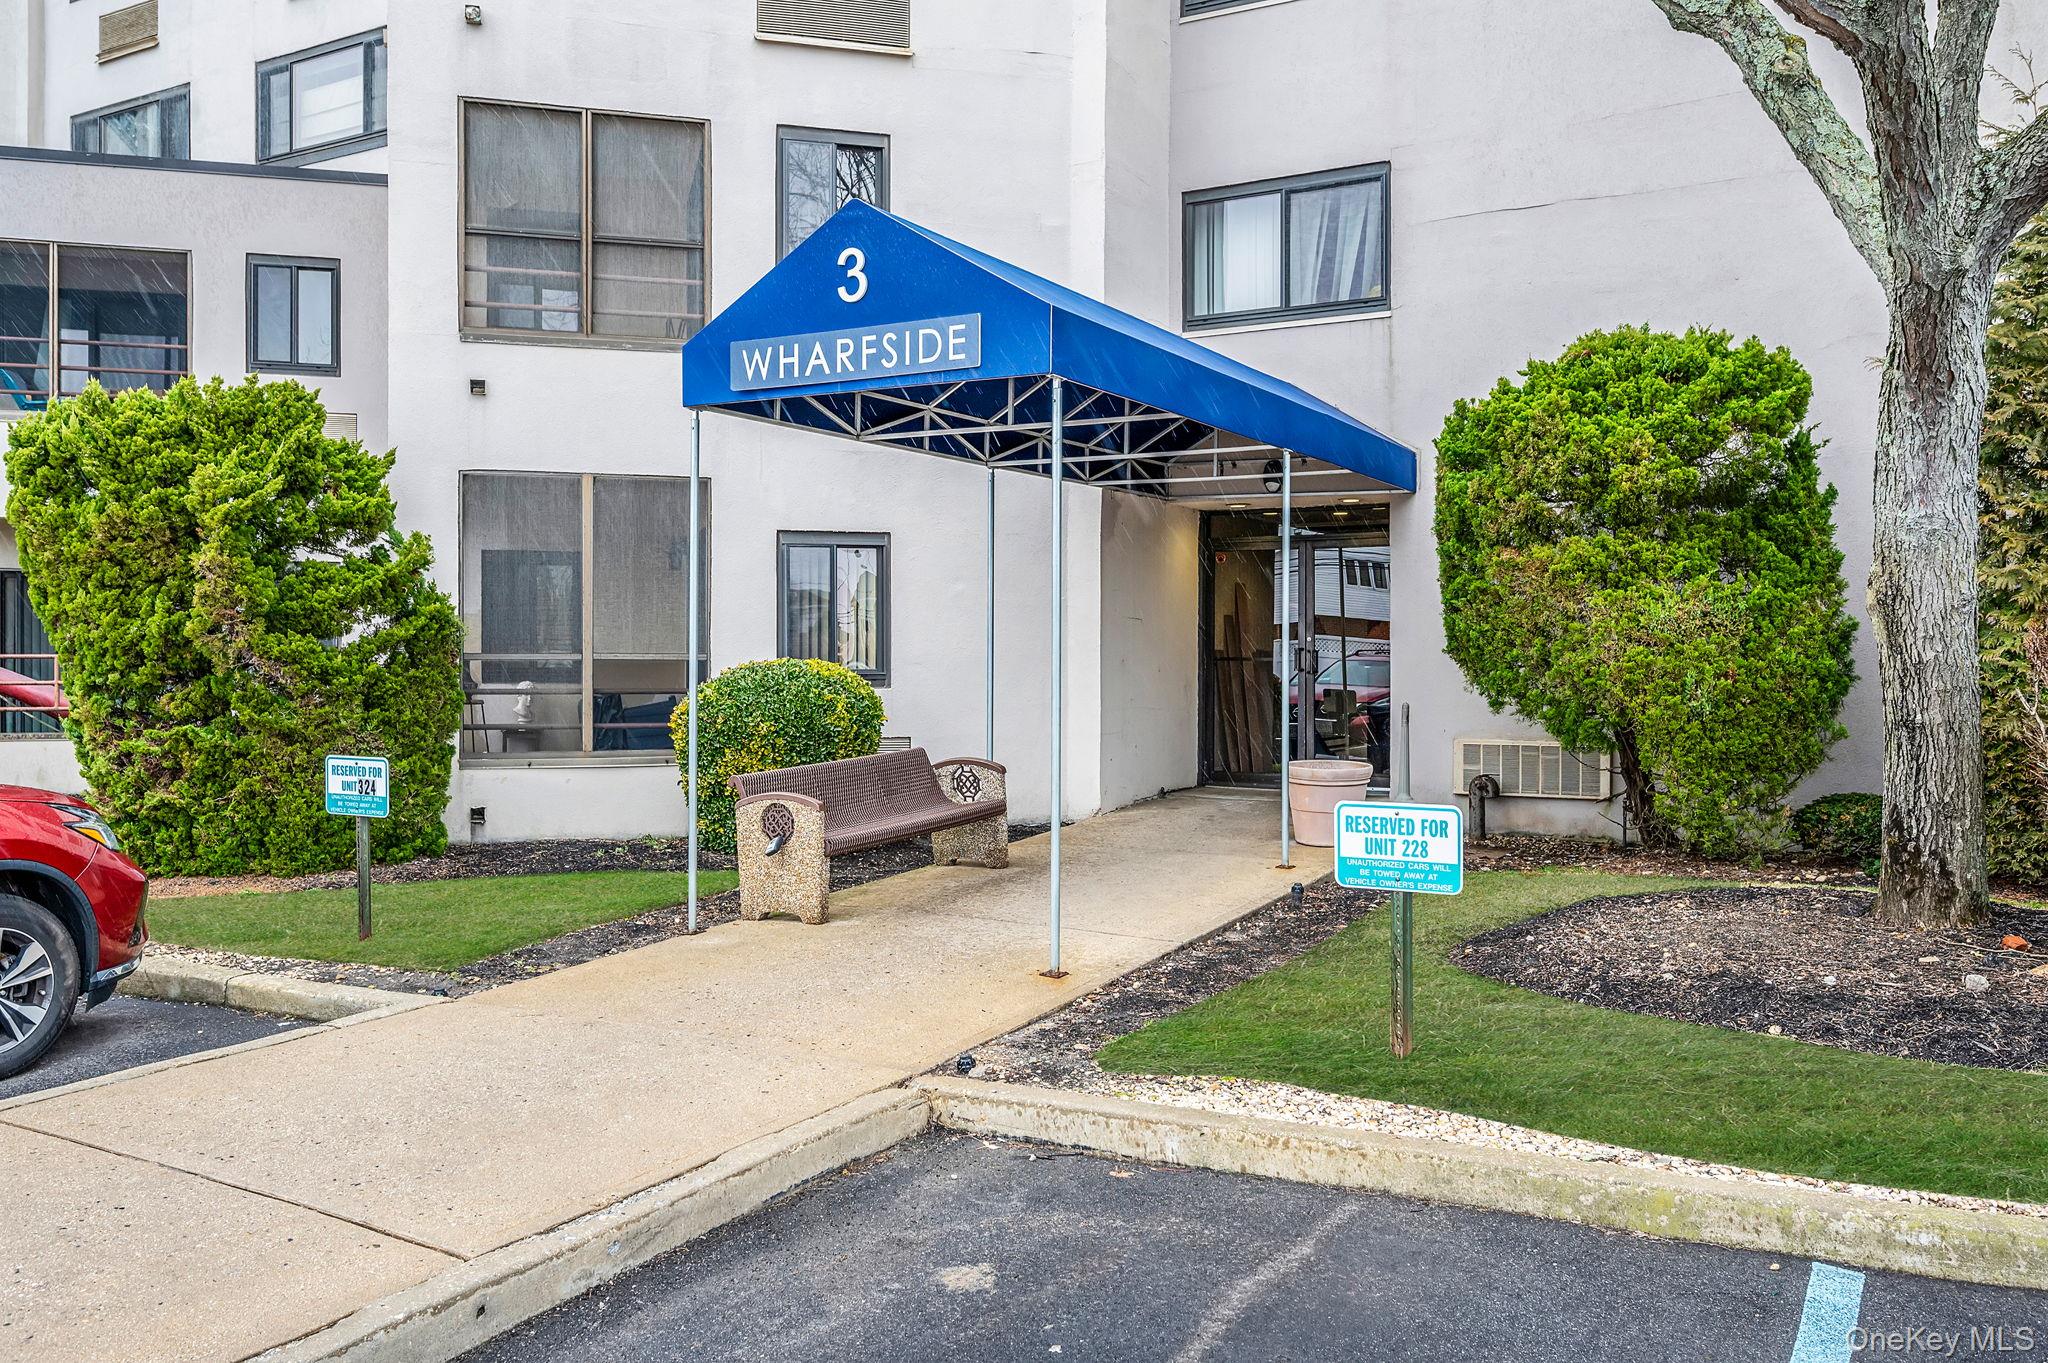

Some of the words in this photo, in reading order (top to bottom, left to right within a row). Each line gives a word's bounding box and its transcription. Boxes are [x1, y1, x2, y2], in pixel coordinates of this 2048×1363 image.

[837, 247, 868, 302] 3
[742, 324, 966, 381] WHARFSIDE
[331, 765, 366, 777] RESERVED
[369, 767, 382, 778] FOR
[342, 780, 357, 792] UNIT
[358, 779, 376, 795] 324
[1345, 815, 1415, 836] RESERVED
[1421, 819, 1449, 838] FOR
[1364, 837, 1397, 856] UNIT
[1402, 839, 1429, 858] 228
[1347, 859, 1405, 869] UNAUTHORIZED
[1408, 862, 1430, 871] CARS
[1432, 864, 1451, 872] WILL
[1373, 870, 1400, 878] TOWED
[1403, 871, 1425, 879] AWAY
[1345, 877, 1376, 886] VEHICLE
[1379, 879, 1414, 889] OWNER'S
[1418, 883, 1453, 892] EXPENSE
